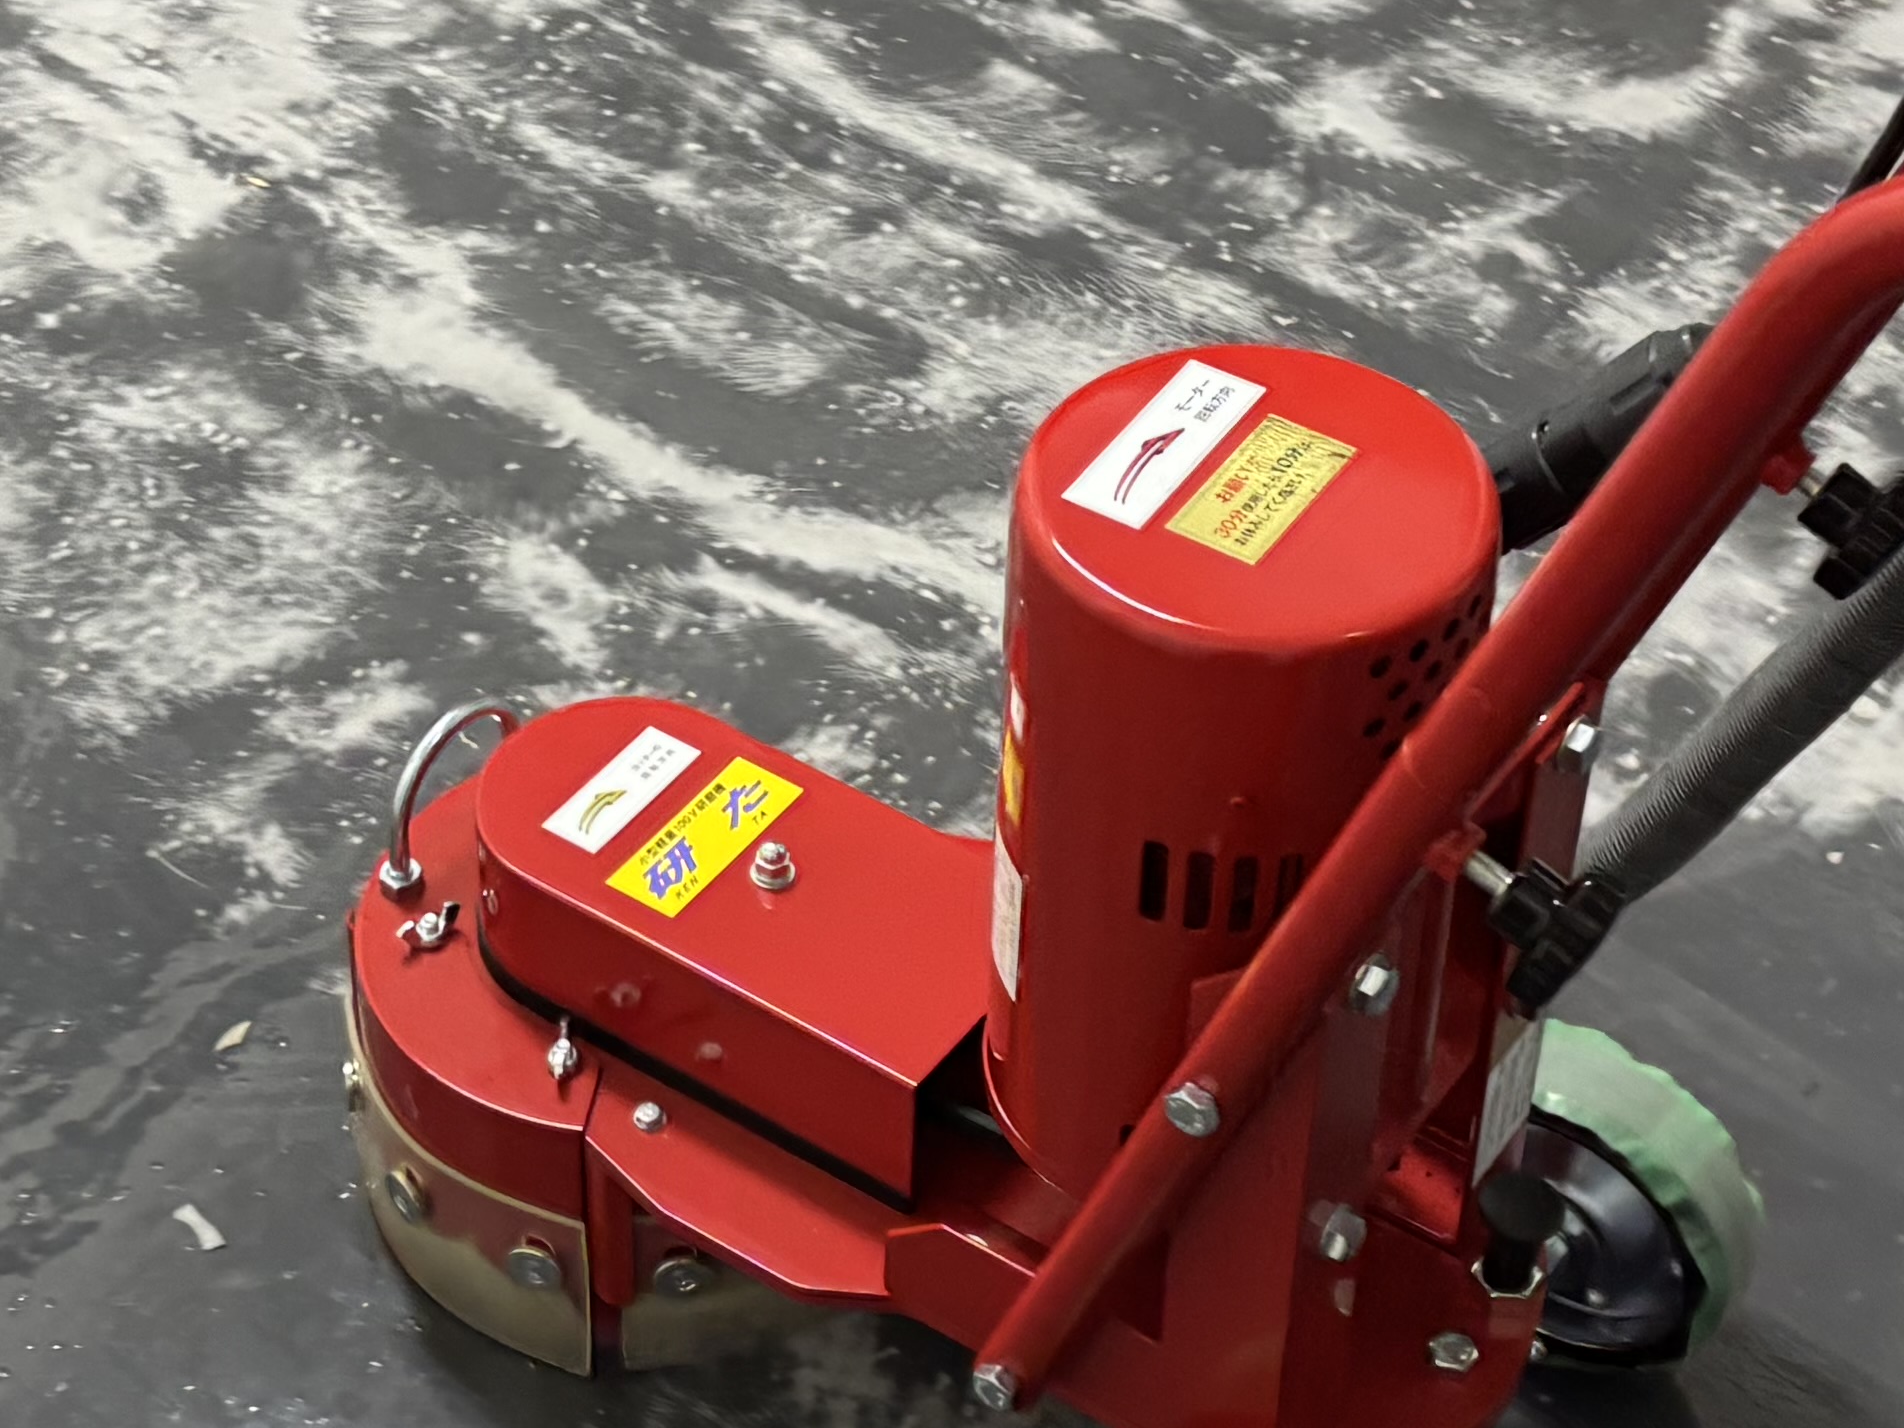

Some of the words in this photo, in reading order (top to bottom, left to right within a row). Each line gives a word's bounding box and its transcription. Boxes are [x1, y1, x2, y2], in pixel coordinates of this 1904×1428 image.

[1174, 377, 1214, 412] モーター
[1194, 385, 1235, 423] 回転方向
[673, 875, 701, 899] KEN
[751, 809, 768, 825] TA
